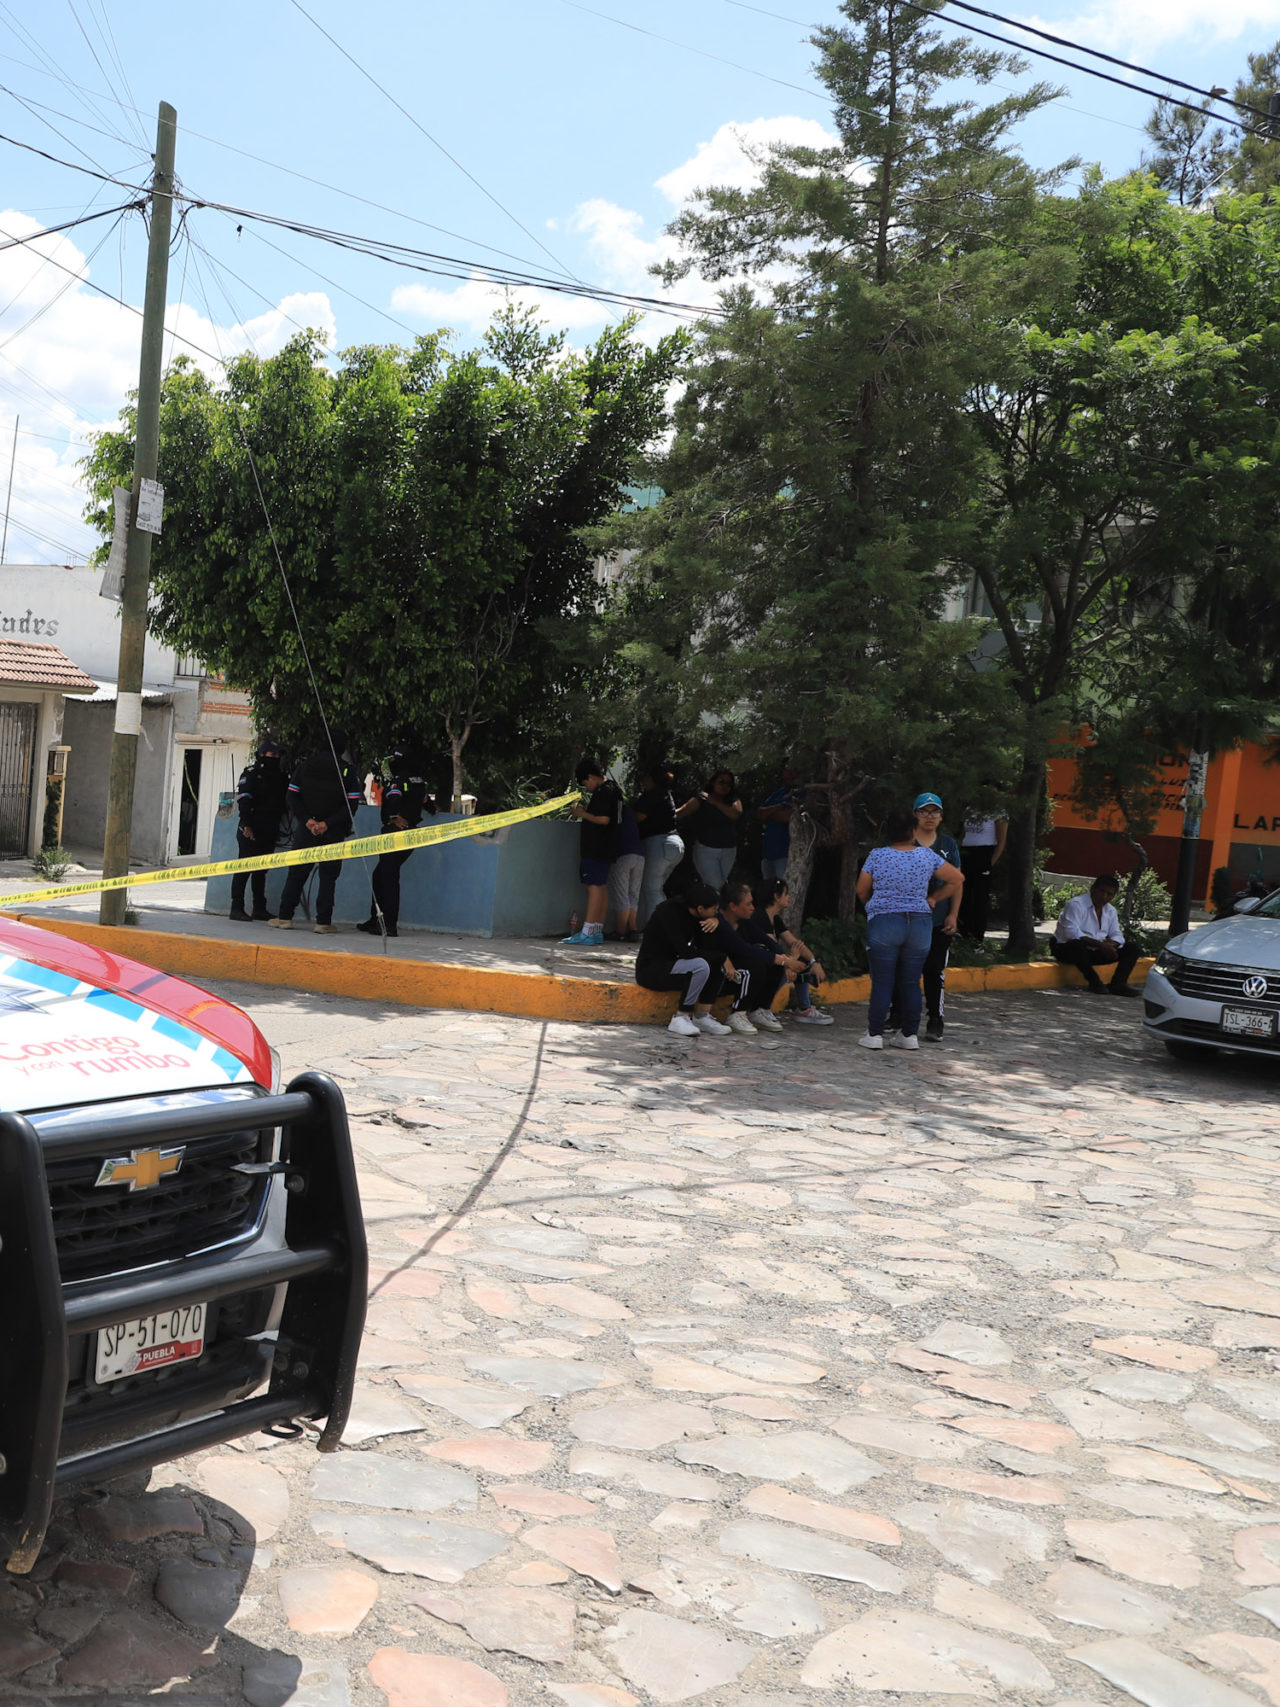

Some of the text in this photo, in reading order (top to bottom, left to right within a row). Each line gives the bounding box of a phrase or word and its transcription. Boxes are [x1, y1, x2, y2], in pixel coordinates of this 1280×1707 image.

[31, 1059, 64, 1072] con
[68, 1049, 192, 1077] rumbo
[104, 1304, 202, 1358] SP-51-070
[142, 1346, 176, 1363] PUEBLA
